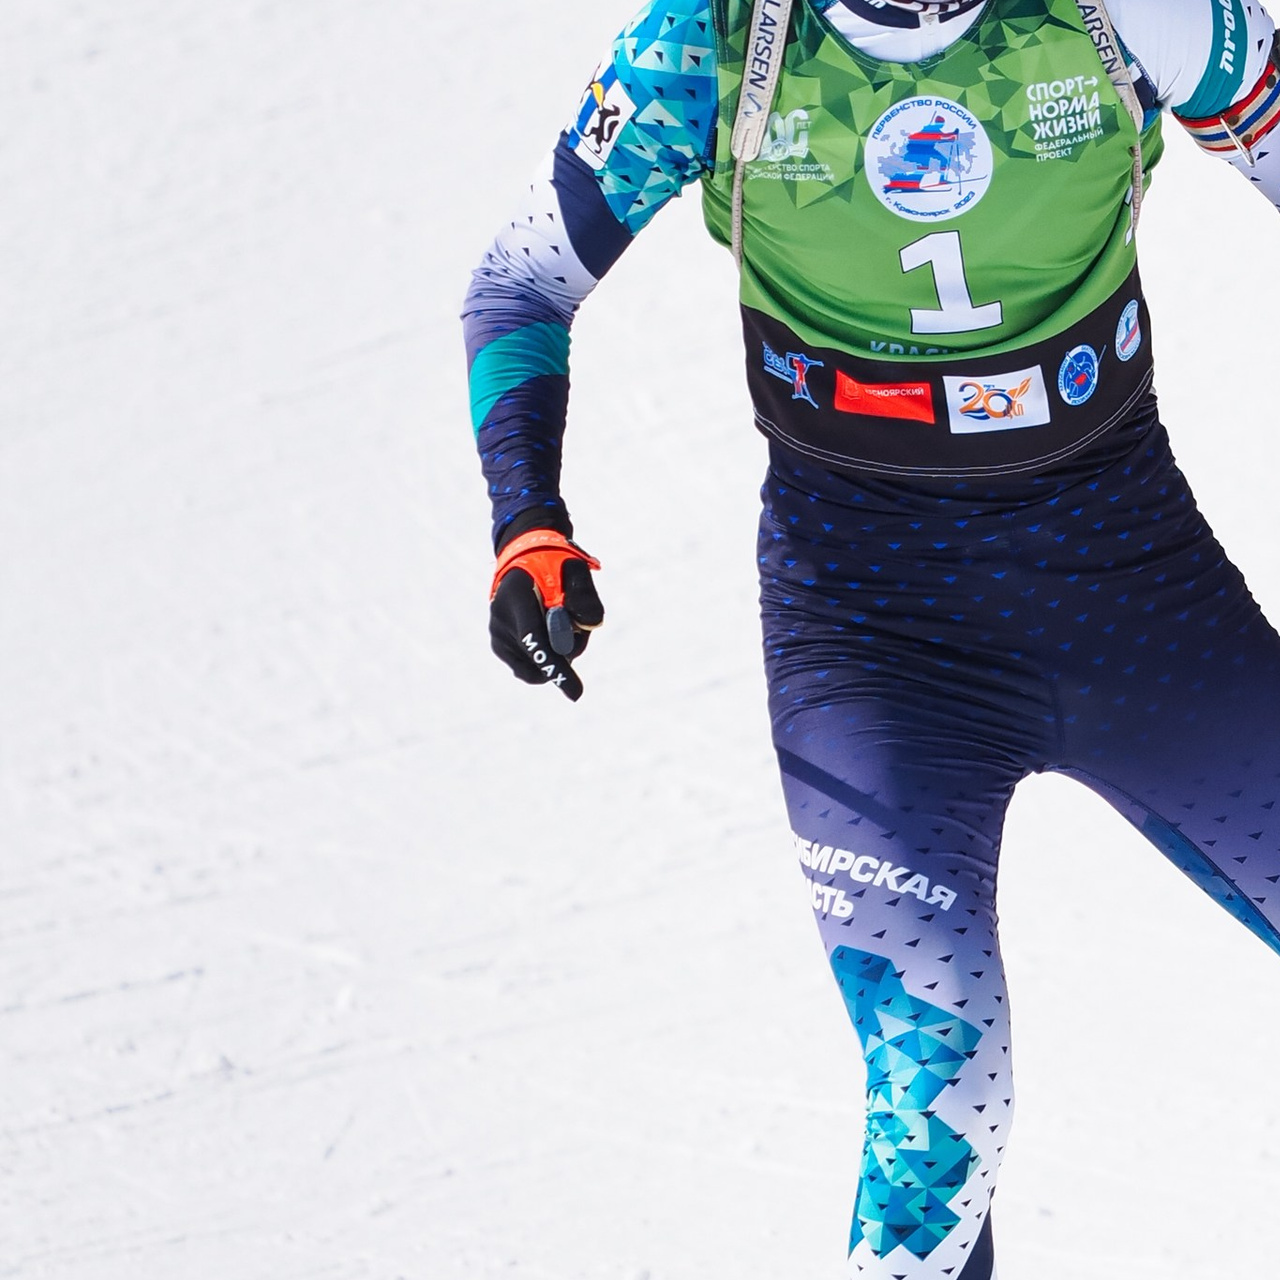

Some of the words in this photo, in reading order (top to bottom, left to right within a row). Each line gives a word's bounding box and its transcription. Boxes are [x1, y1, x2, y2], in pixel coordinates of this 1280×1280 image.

[1026, 75, 1084, 102] СПОРТ
[871, 99, 933, 140] ПЕРВЕНСТВО
[934, 100, 978, 130] РОССИИ
[1029, 91, 1100, 121] НОРМА
[1032, 108, 1102, 140] ЖИЗНИ
[1034, 126, 1104, 151] ФЕДЕРАЛЬНЫЙ
[799, 163, 831, 172] СПОРТА
[1036, 147, 1073, 162] ПРОЕКТ
[783, 172, 835, 182] ФЕДЕРАЦИИ
[893, 201, 951, 217] Красноярск
[953, 190, 976, 210] 2023
[898, 229, 1004, 335] 1
[522, 633, 566, 686] MOAX
[806, 878, 854, 918] СТЬ
